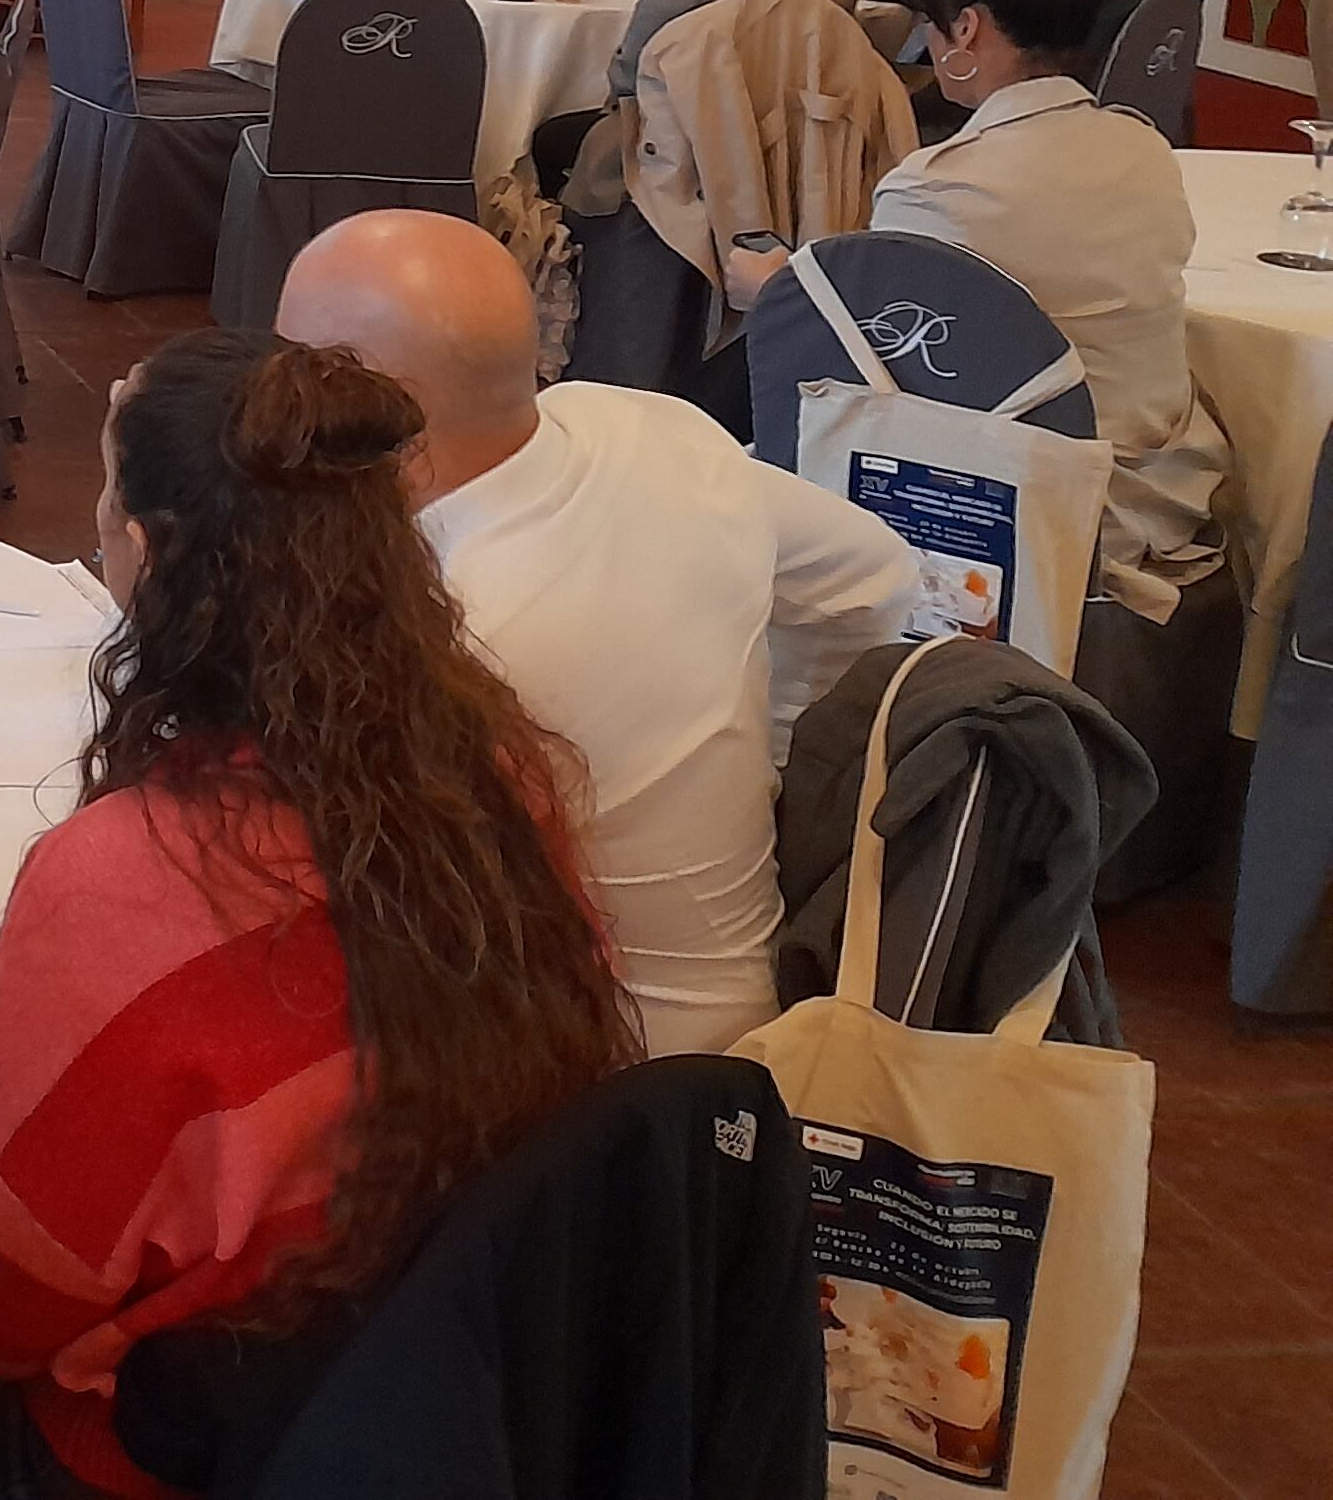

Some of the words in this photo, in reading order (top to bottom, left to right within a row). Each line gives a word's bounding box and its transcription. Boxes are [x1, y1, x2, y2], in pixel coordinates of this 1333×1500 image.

[872, 1178, 933, 1212] CUANDO
[936, 1205, 952, 1217] EL
[1001, 1208, 1018, 1221] SE
